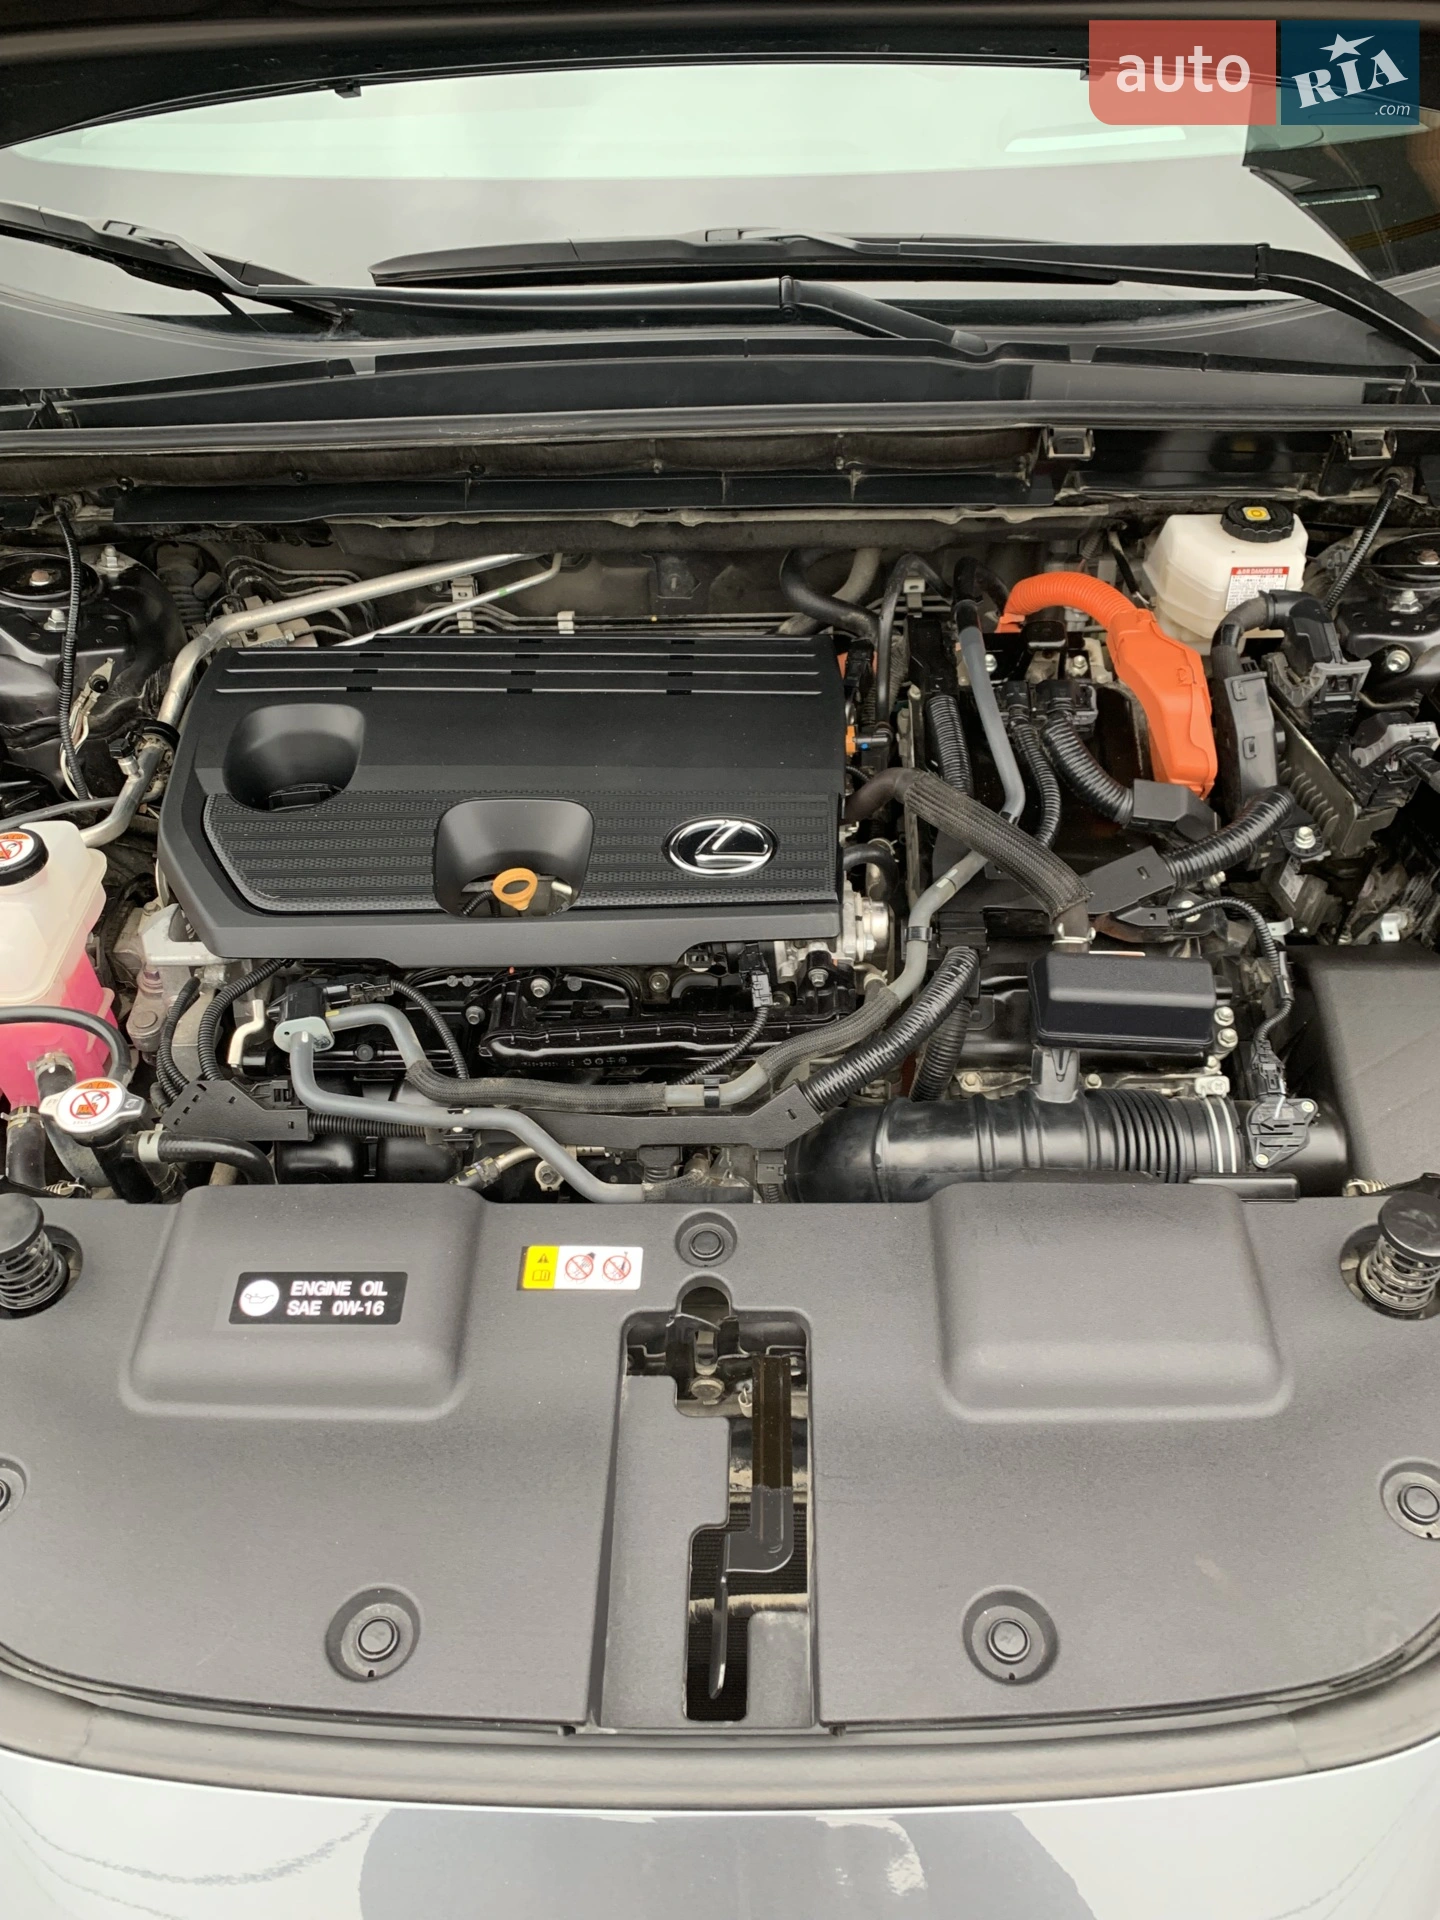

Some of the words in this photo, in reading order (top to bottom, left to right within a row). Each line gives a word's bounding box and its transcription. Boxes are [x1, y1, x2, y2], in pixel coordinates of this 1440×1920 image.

[1250, 567, 1273, 575] DANGER
[290, 1281, 352, 1296] ENGINE
[360, 1281, 388, 1296] OIL
[286, 1300, 322, 1316] SAE
[332, 1300, 385, 1316] 0W-16
